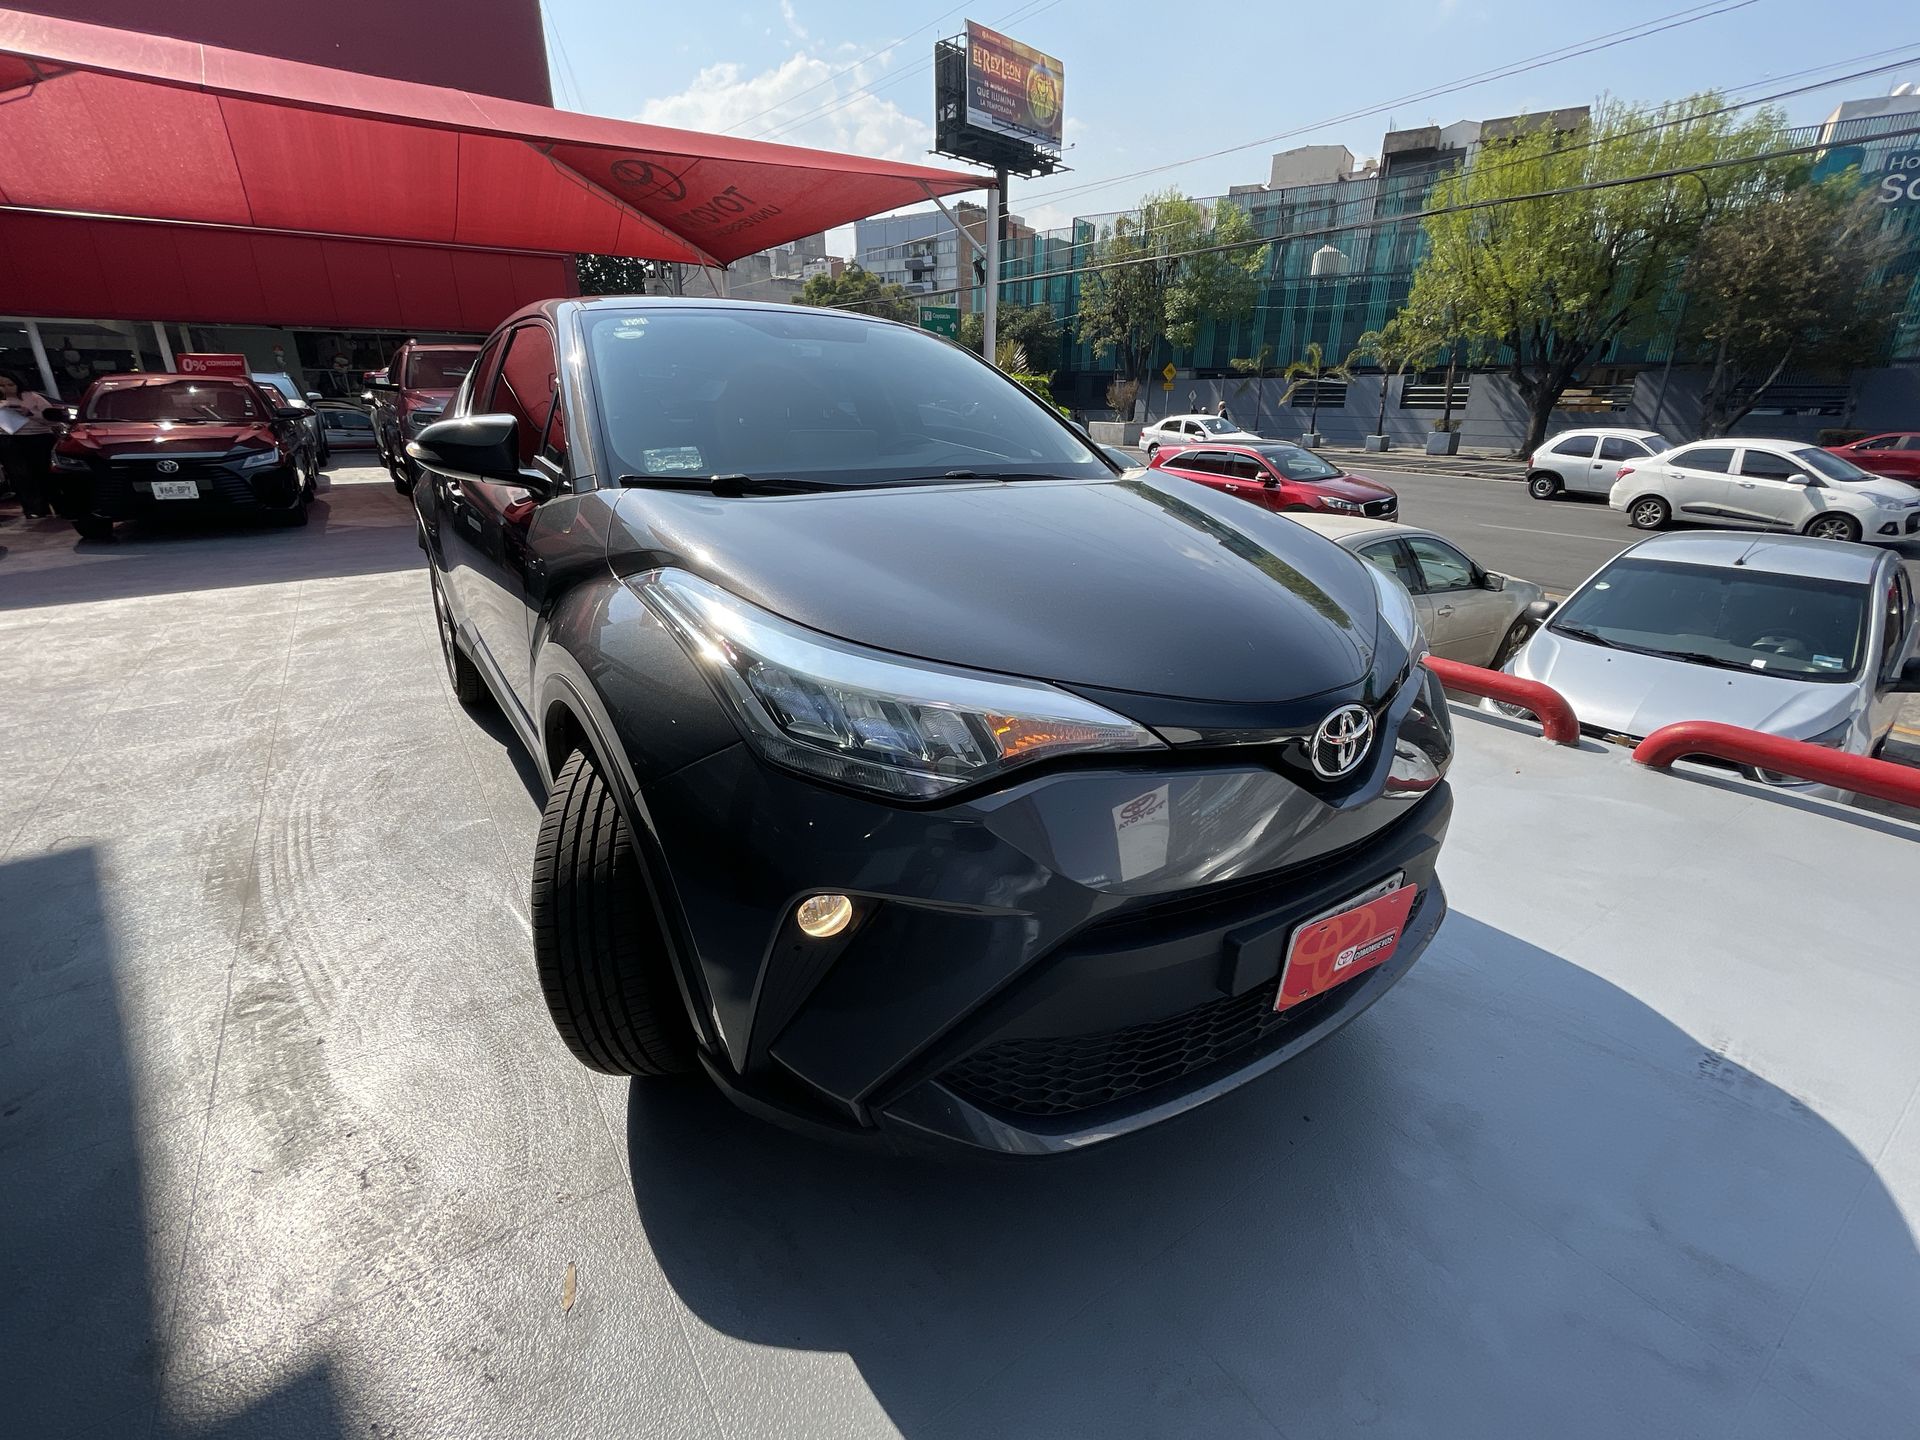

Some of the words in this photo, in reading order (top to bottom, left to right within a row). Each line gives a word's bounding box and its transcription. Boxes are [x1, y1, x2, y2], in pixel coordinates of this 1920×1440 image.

[976, 86, 989, 98] QUE
[991, 91, 1016, 108] ILUMINA
[182, 358, 207, 372] 0%
